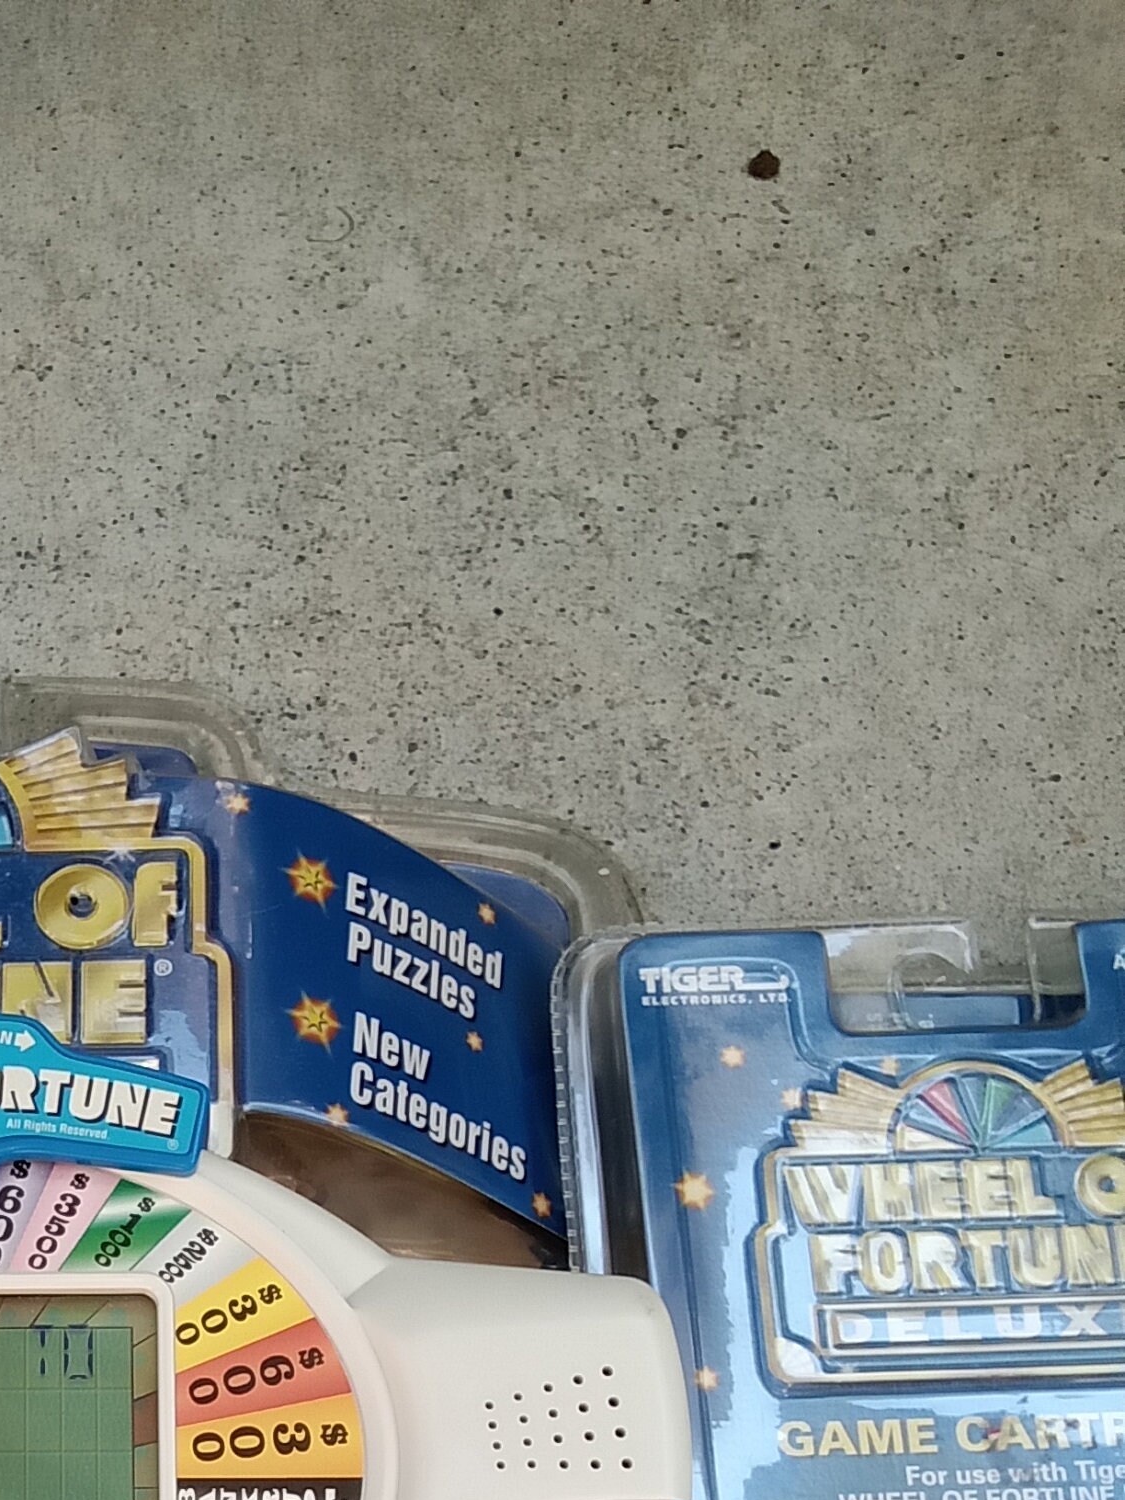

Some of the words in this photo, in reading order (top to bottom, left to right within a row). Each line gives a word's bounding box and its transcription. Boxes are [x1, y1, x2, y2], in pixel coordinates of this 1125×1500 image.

[345, 871, 503, 989] Expanded
[347, 920, 476, 1020] Puzzles
[638, 965, 790, 995] TIGER
[352, 1011, 432, 1082] New
[6, 1117, 22, 1129] All
[24, 1119, 57, 1134] Rights
[59, 1122, 109, 1140] Reserved.
[350, 1061, 528, 1182] Categories
[28, 1172, 90, 1271] $350
[782, 1158, 1058, 1226] WHEEL
[809, 1226, 1125, 1296] FORTUN
[174, 1284, 283, 1345] $300
[30, 1324, 94, 1379] TO
[188, 1347, 325, 1405] $600
[192, 1422, 348, 1462] $300
[778, 1418, 939, 1457] GAME
[906, 1465, 946, 1487] For
[956, 1465, 1001, 1486] use
[1007, 1461, 1067, 1485] with
